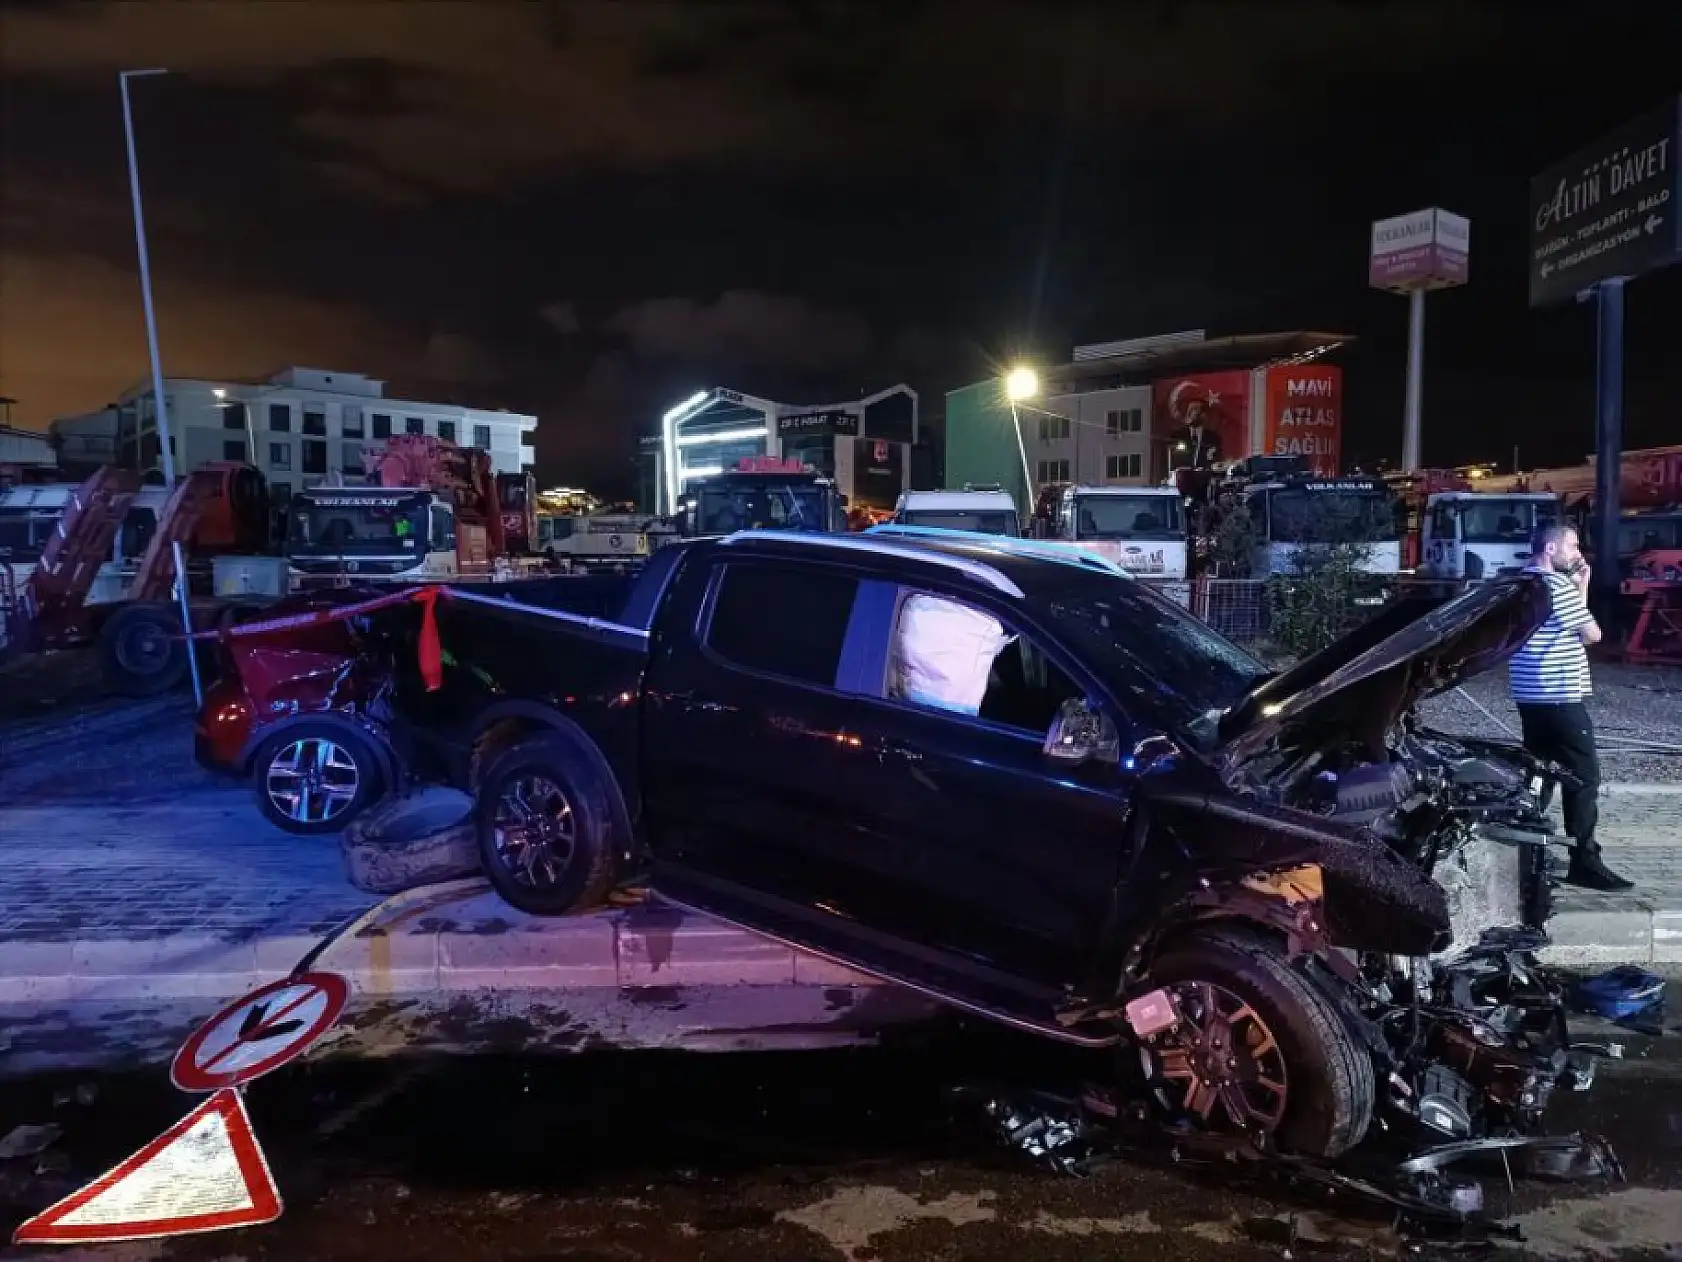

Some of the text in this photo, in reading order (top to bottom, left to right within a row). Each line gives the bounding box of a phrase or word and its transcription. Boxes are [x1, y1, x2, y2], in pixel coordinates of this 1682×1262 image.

[1535, 173, 1601, 231] ALTIN
[1610, 137, 1670, 195] DAVET
[1287, 376, 1333, 398] MAVİ
[1279, 406, 1336, 428] ATLAS
[1305, 481, 1374, 491] VOLKANLAR
